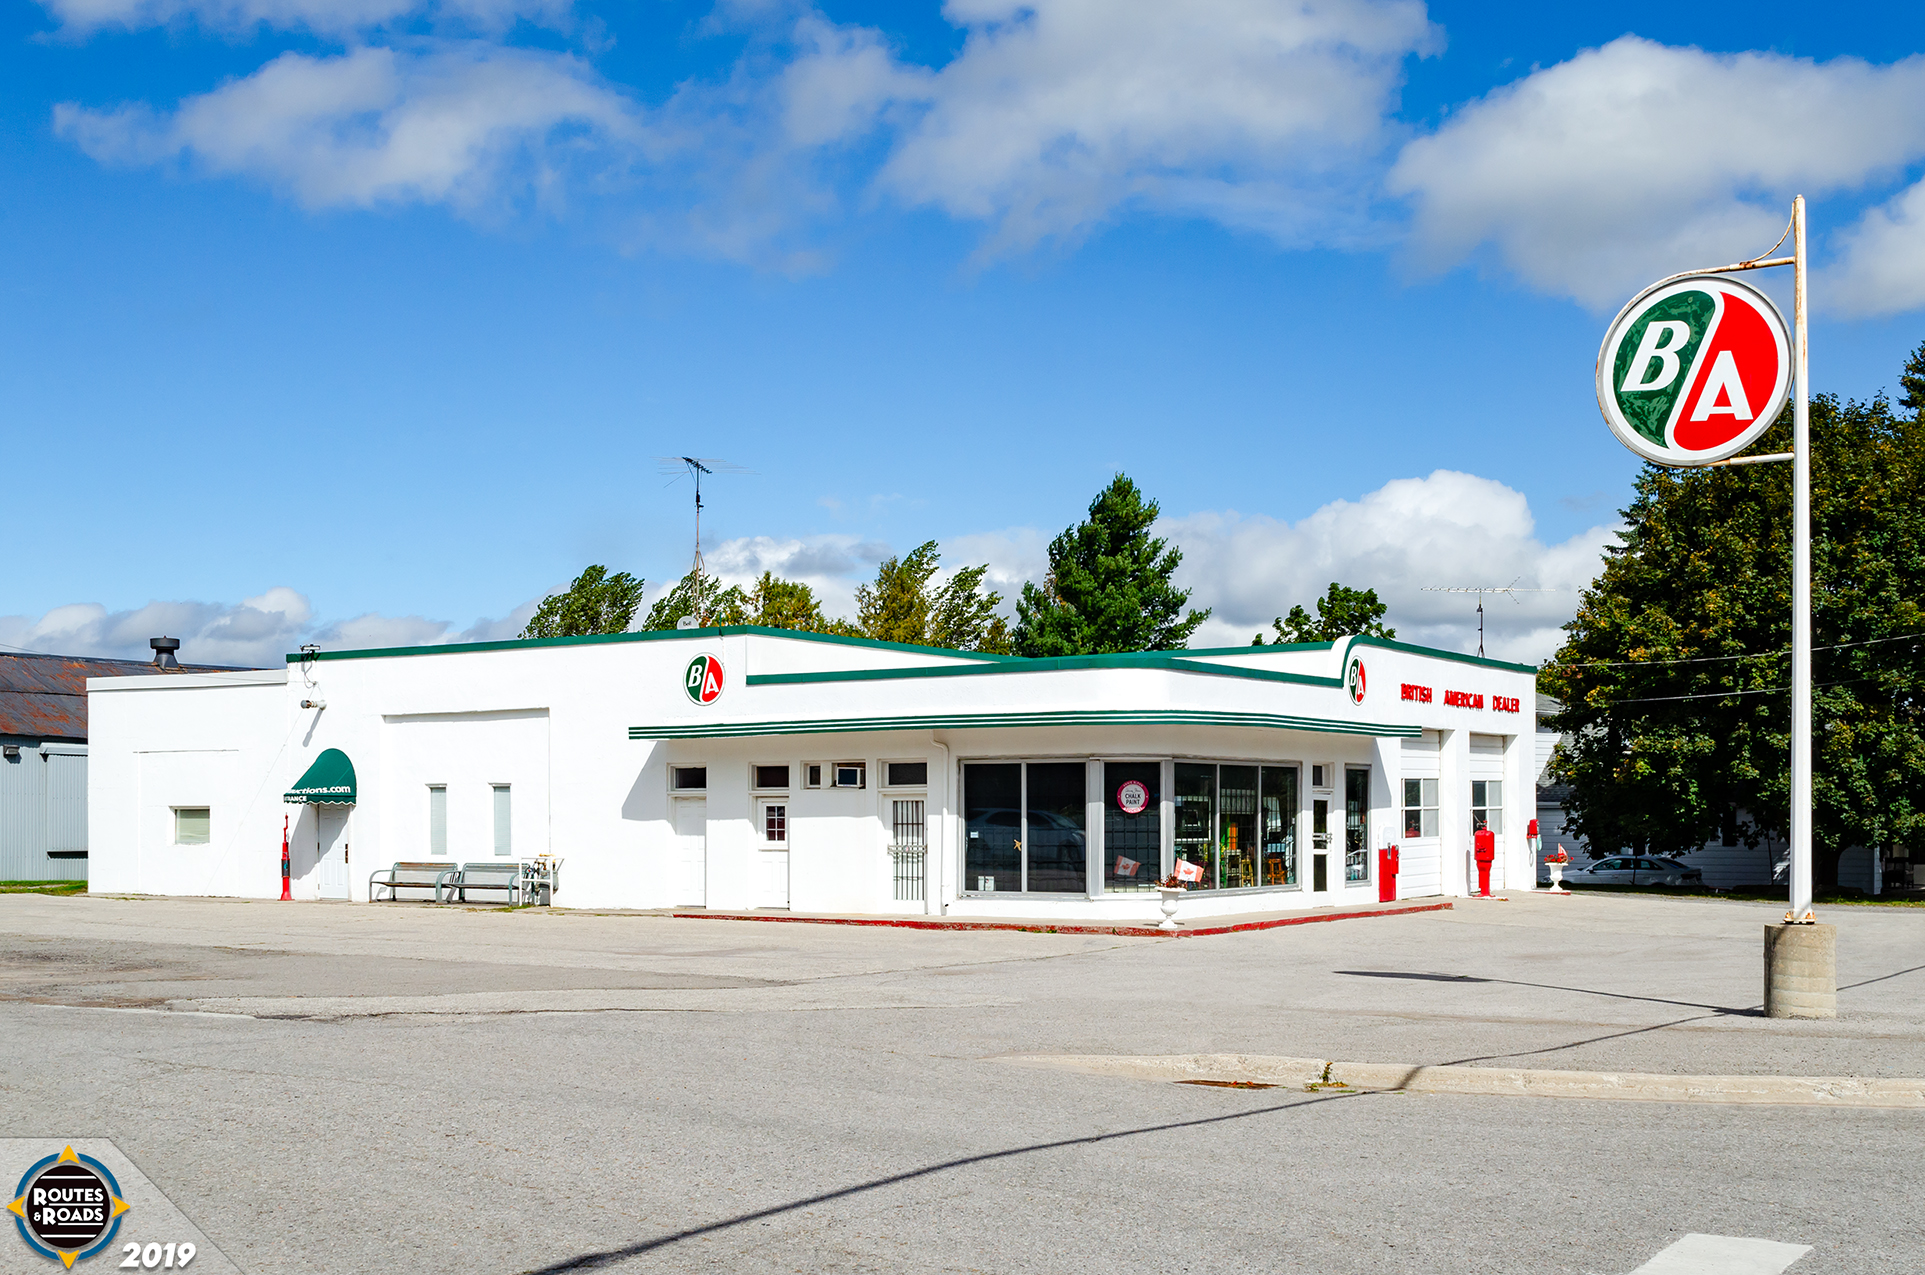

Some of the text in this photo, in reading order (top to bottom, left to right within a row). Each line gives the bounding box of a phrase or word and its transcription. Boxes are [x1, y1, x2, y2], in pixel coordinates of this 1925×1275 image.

[1401, 683, 1520, 713] BRITISH AMERICAN DEALER
